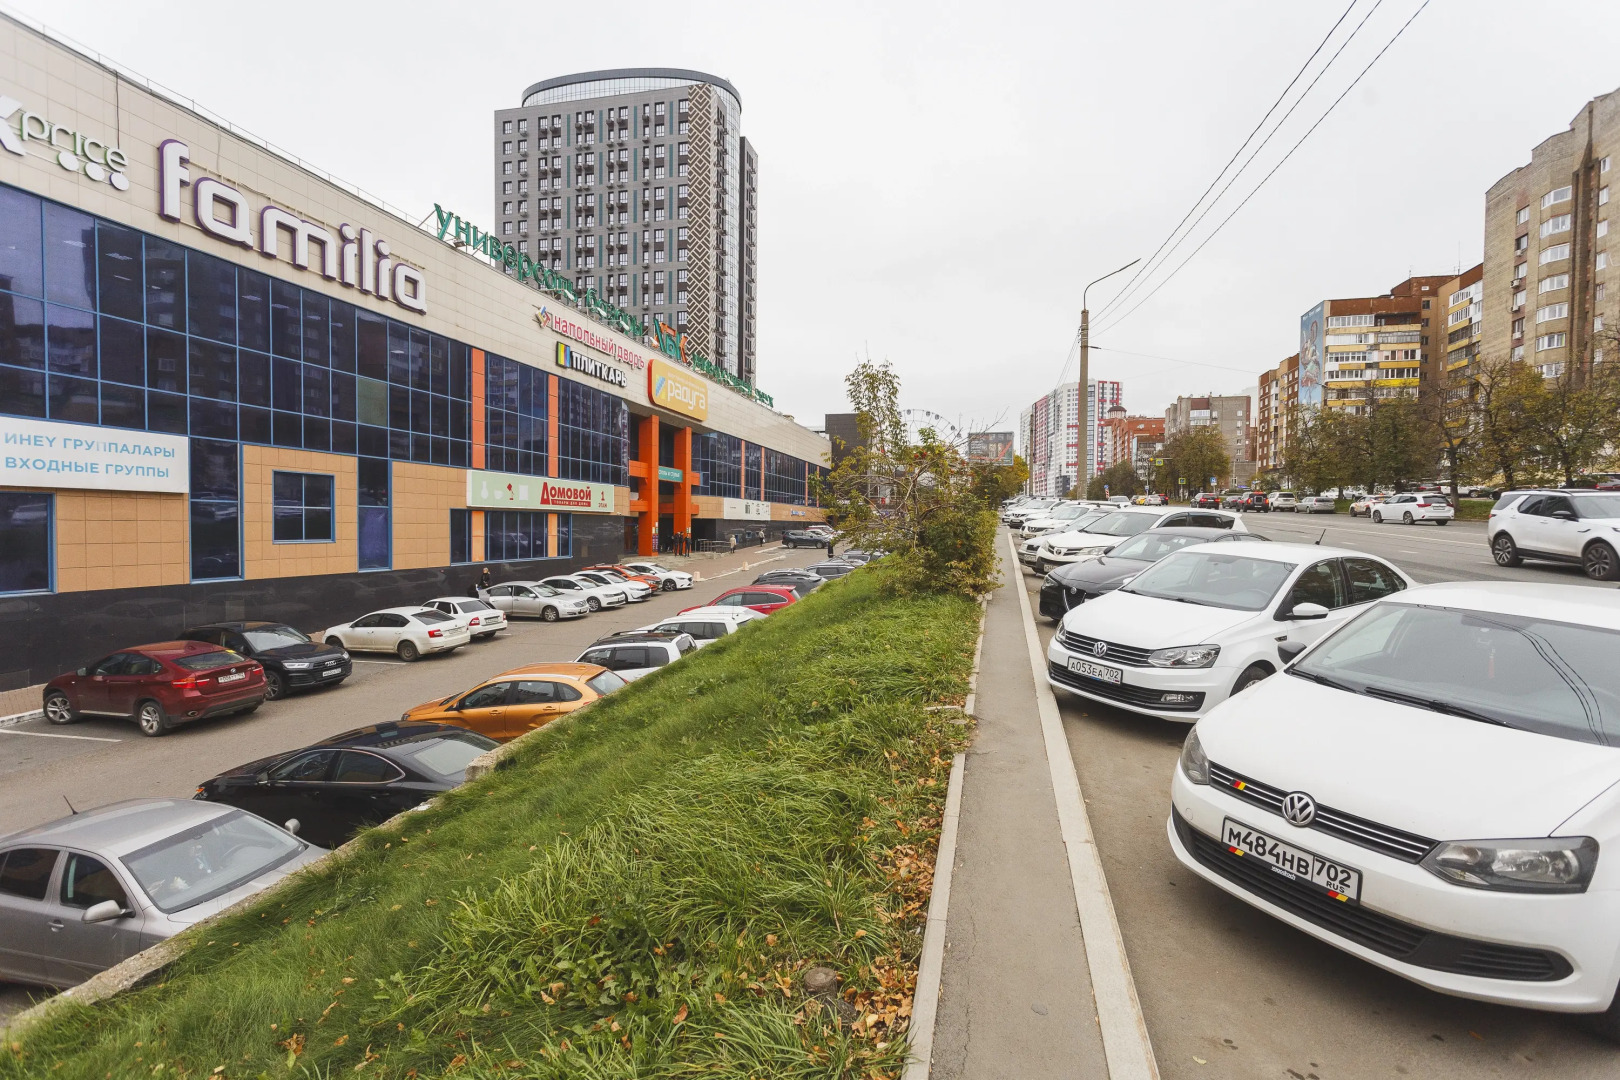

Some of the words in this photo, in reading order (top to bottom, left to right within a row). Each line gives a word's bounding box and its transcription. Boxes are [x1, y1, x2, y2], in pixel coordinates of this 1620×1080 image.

[20, 110, 129, 171] price
[158, 138, 428, 316] familia
[554, 315, 615, 356] напольный
[571, 350, 627, 388] ПЛИТКАРЬ
[5, 457, 100, 474] ВХОДНЫЕ
[105, 463, 169, 478] ГРУППЫ
[601, 491, 605, 501] 1
[1104, 667, 1119, 680] 702
[1315, 857, 1352, 888] 702
[1326, 880, 1345, 894] RUS
